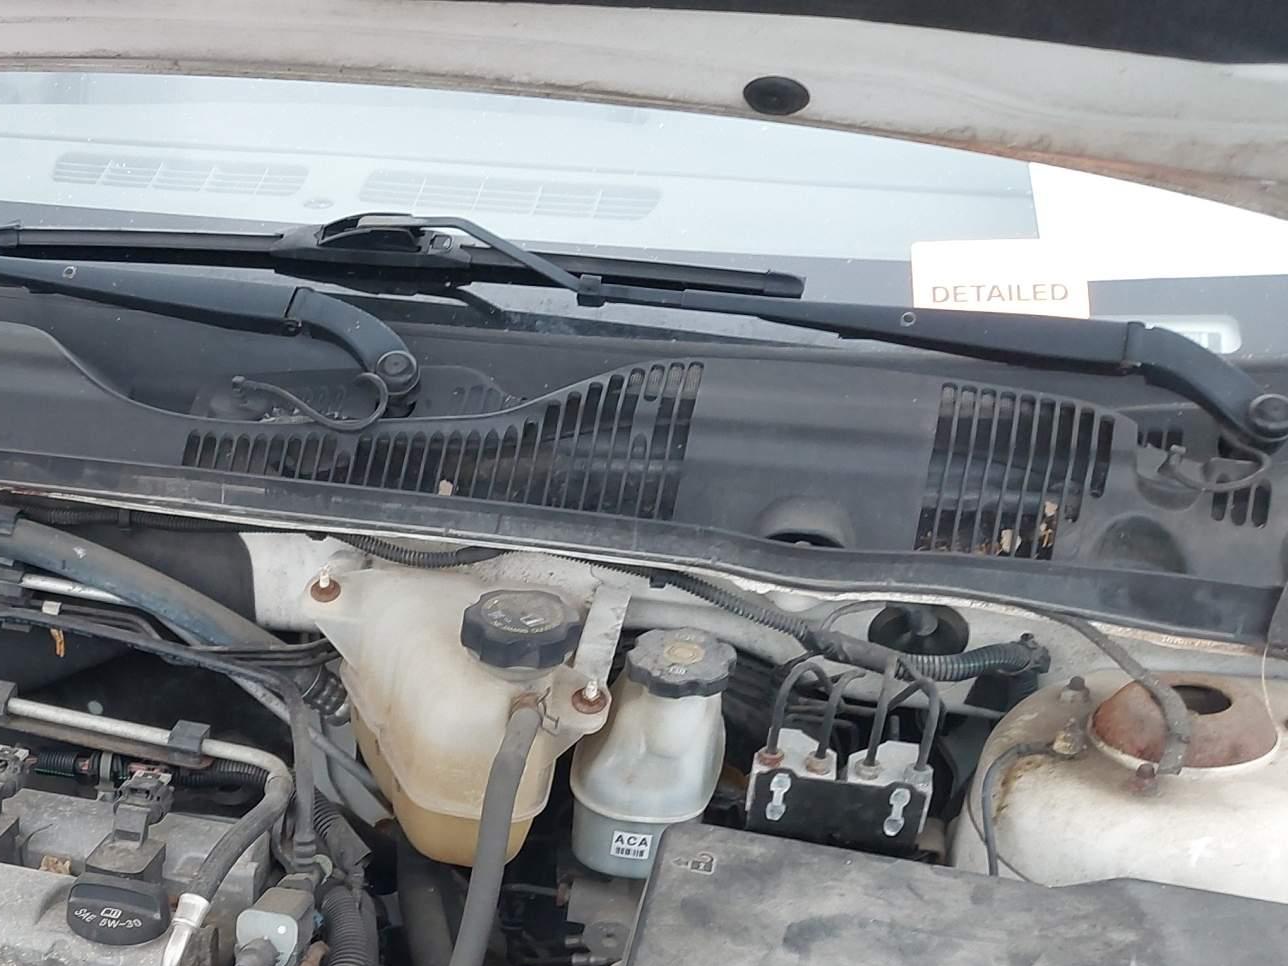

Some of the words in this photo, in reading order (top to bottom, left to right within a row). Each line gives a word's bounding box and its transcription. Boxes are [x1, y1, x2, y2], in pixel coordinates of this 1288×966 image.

[931, 283, 1069, 303] DETAILED
[614, 834, 649, 848] ACA
[74, 908, 97, 922] SAE
[98, 917, 143, 929] 5W-30
